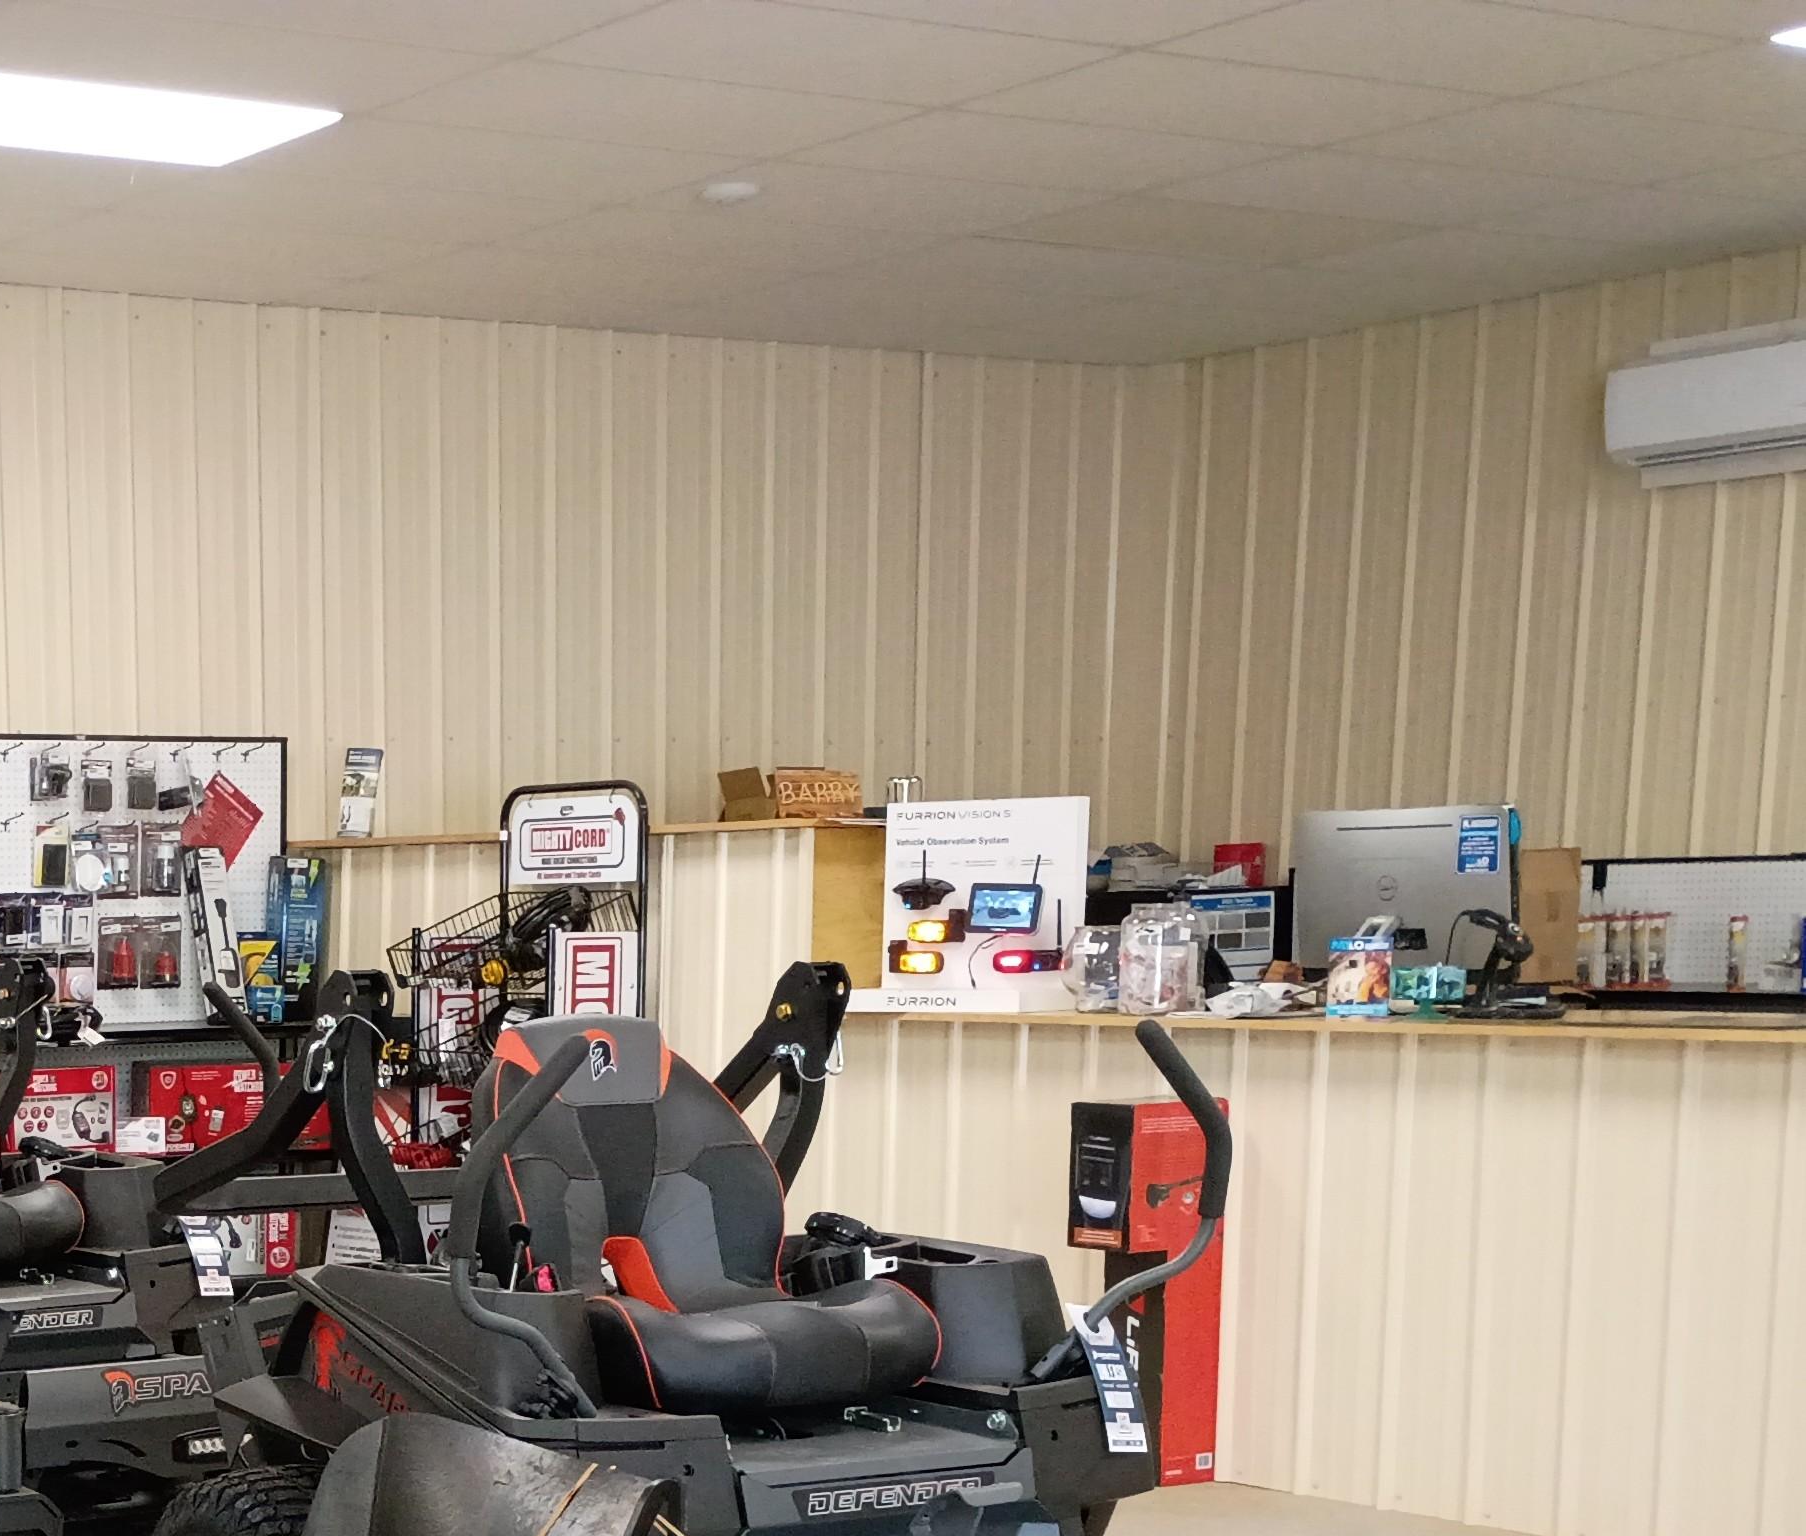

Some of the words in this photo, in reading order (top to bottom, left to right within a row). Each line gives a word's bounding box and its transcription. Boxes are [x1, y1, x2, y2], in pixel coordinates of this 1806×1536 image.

[779, 781, 859, 803] BARRY
[896, 811, 957, 821] FURRION
[575, 829, 606, 848] CORD
[887, 996, 957, 1006] FURRION
